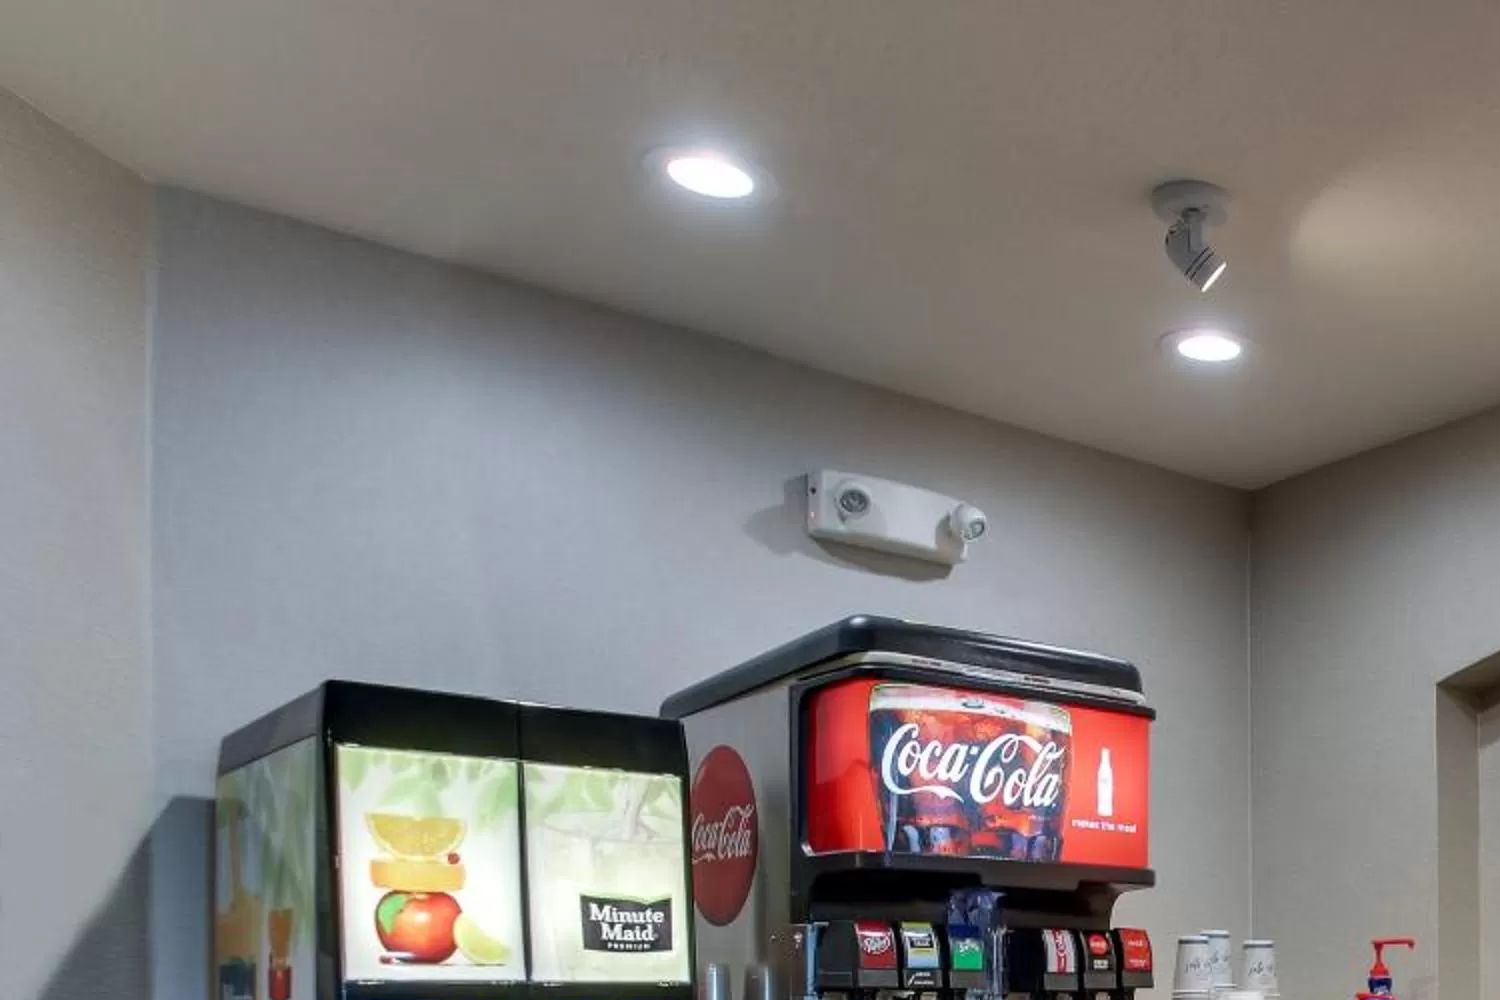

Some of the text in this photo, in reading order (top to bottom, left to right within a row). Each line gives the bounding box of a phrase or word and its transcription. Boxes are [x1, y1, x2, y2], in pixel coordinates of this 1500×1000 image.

[881, 723, 1066, 807] Coca-Cola
[589, 902, 664, 923] Minute
[601, 922, 655, 941] Maid
